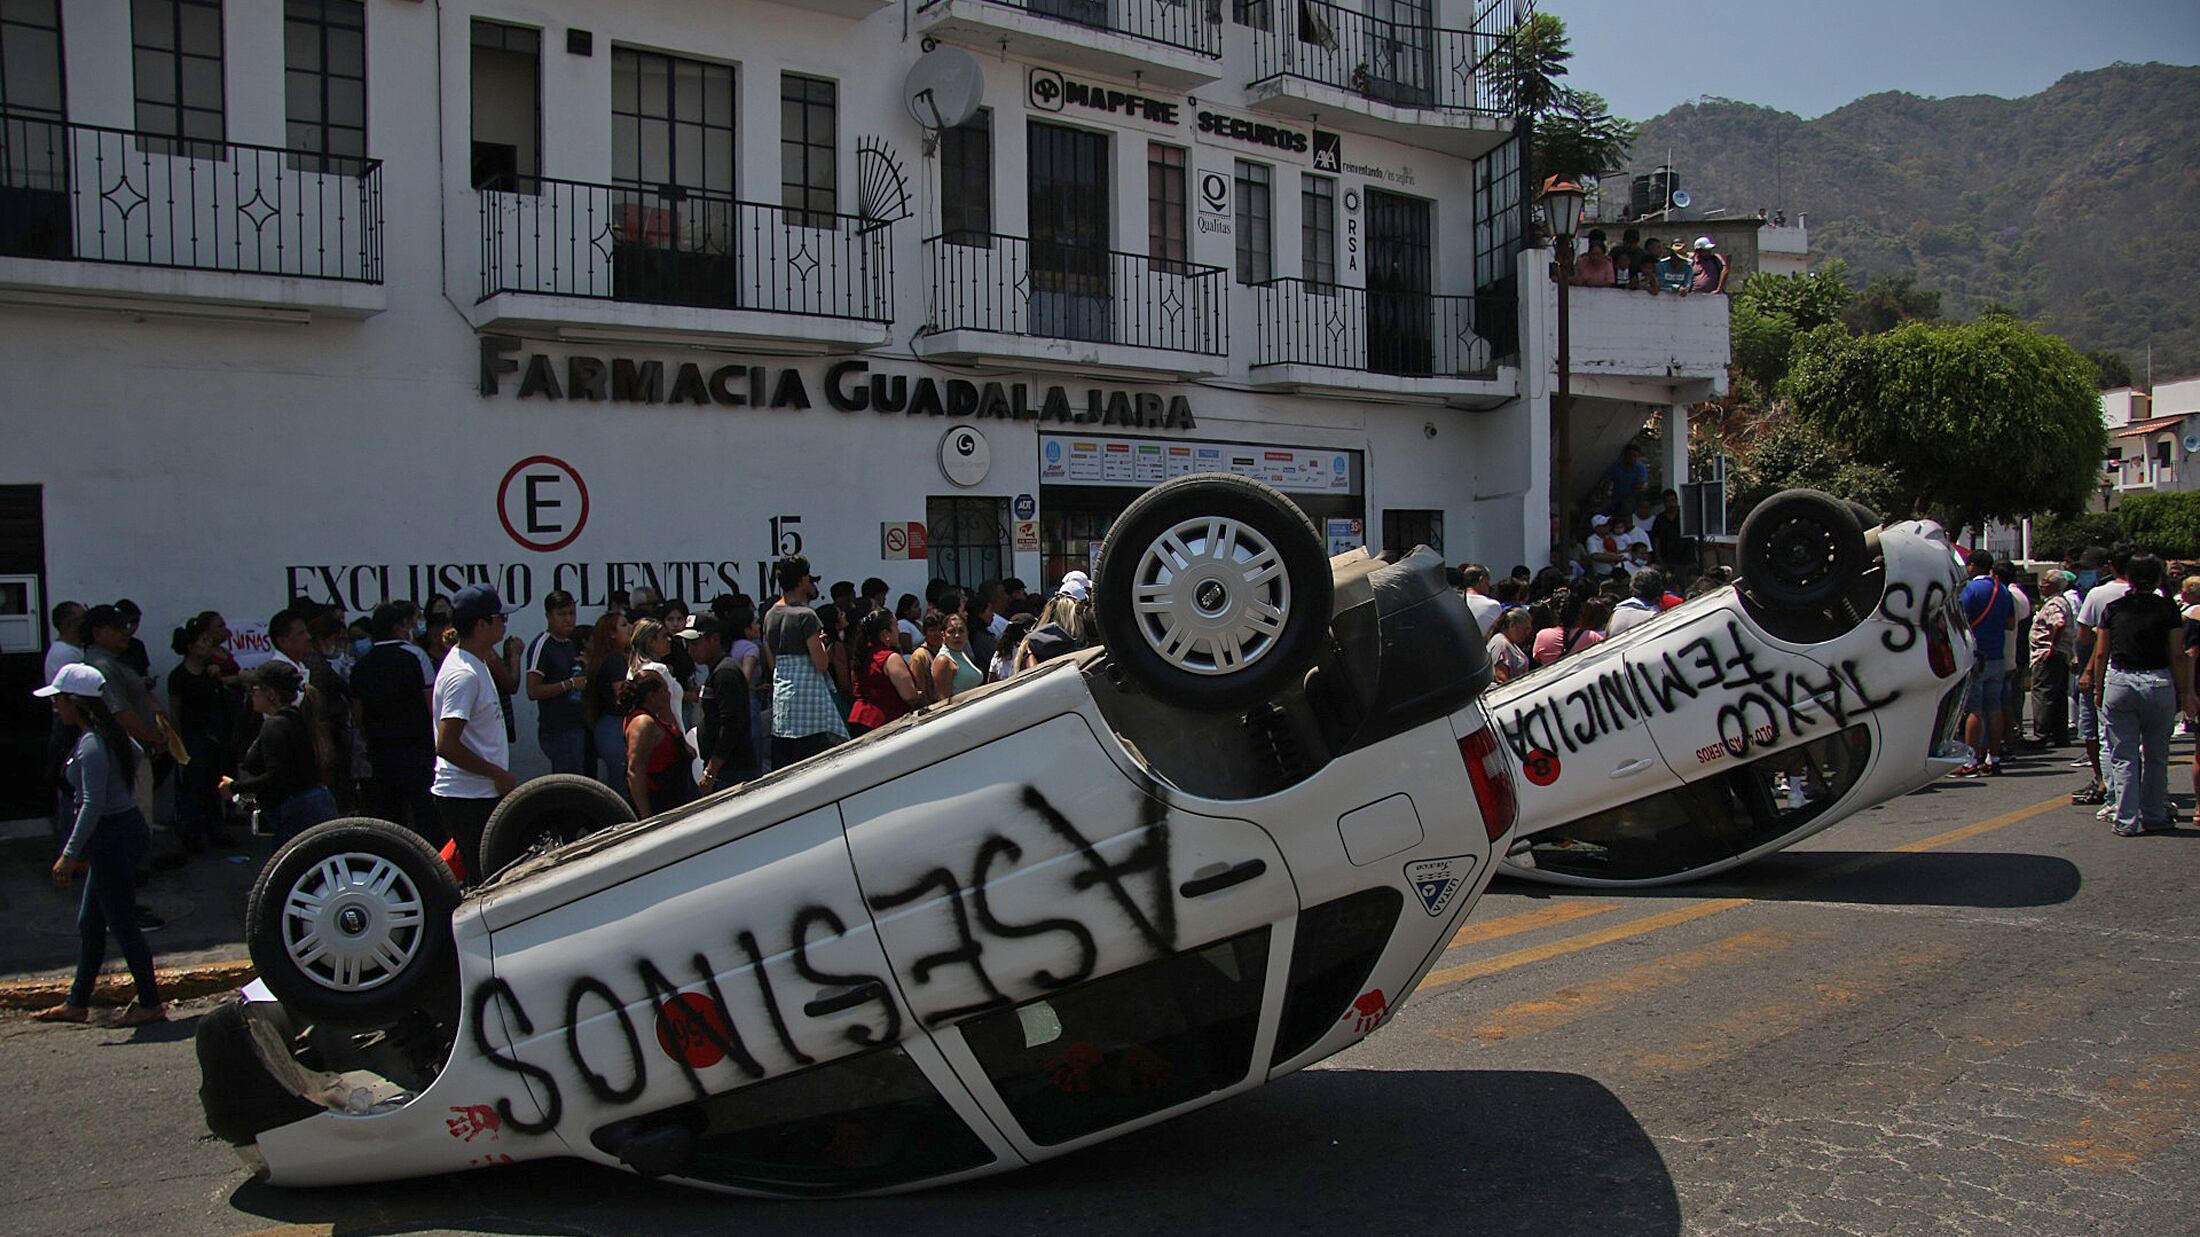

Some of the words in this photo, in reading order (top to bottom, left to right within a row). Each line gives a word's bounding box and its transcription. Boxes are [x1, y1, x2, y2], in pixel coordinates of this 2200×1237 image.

[1065, 82, 1180, 126] MAPFRE
[1197, 111, 1308, 153] SEGUROS
[1313, 146, 1338, 170] AXA
[480, 336, 812, 409] FARMACIA
[824, 360, 1198, 430] GUADALAJARA
[525, 475, 562, 533] E
[769, 515, 803, 556] 15
[1018, 500, 1033, 510] ADT
[553, 561, 740, 608] CLIENTES
[1503, 620, 1775, 765] FEMINICIDA
[1716, 659, 1900, 759] TAXCO
[470, 778, 1178, 1136] ASESINOS
